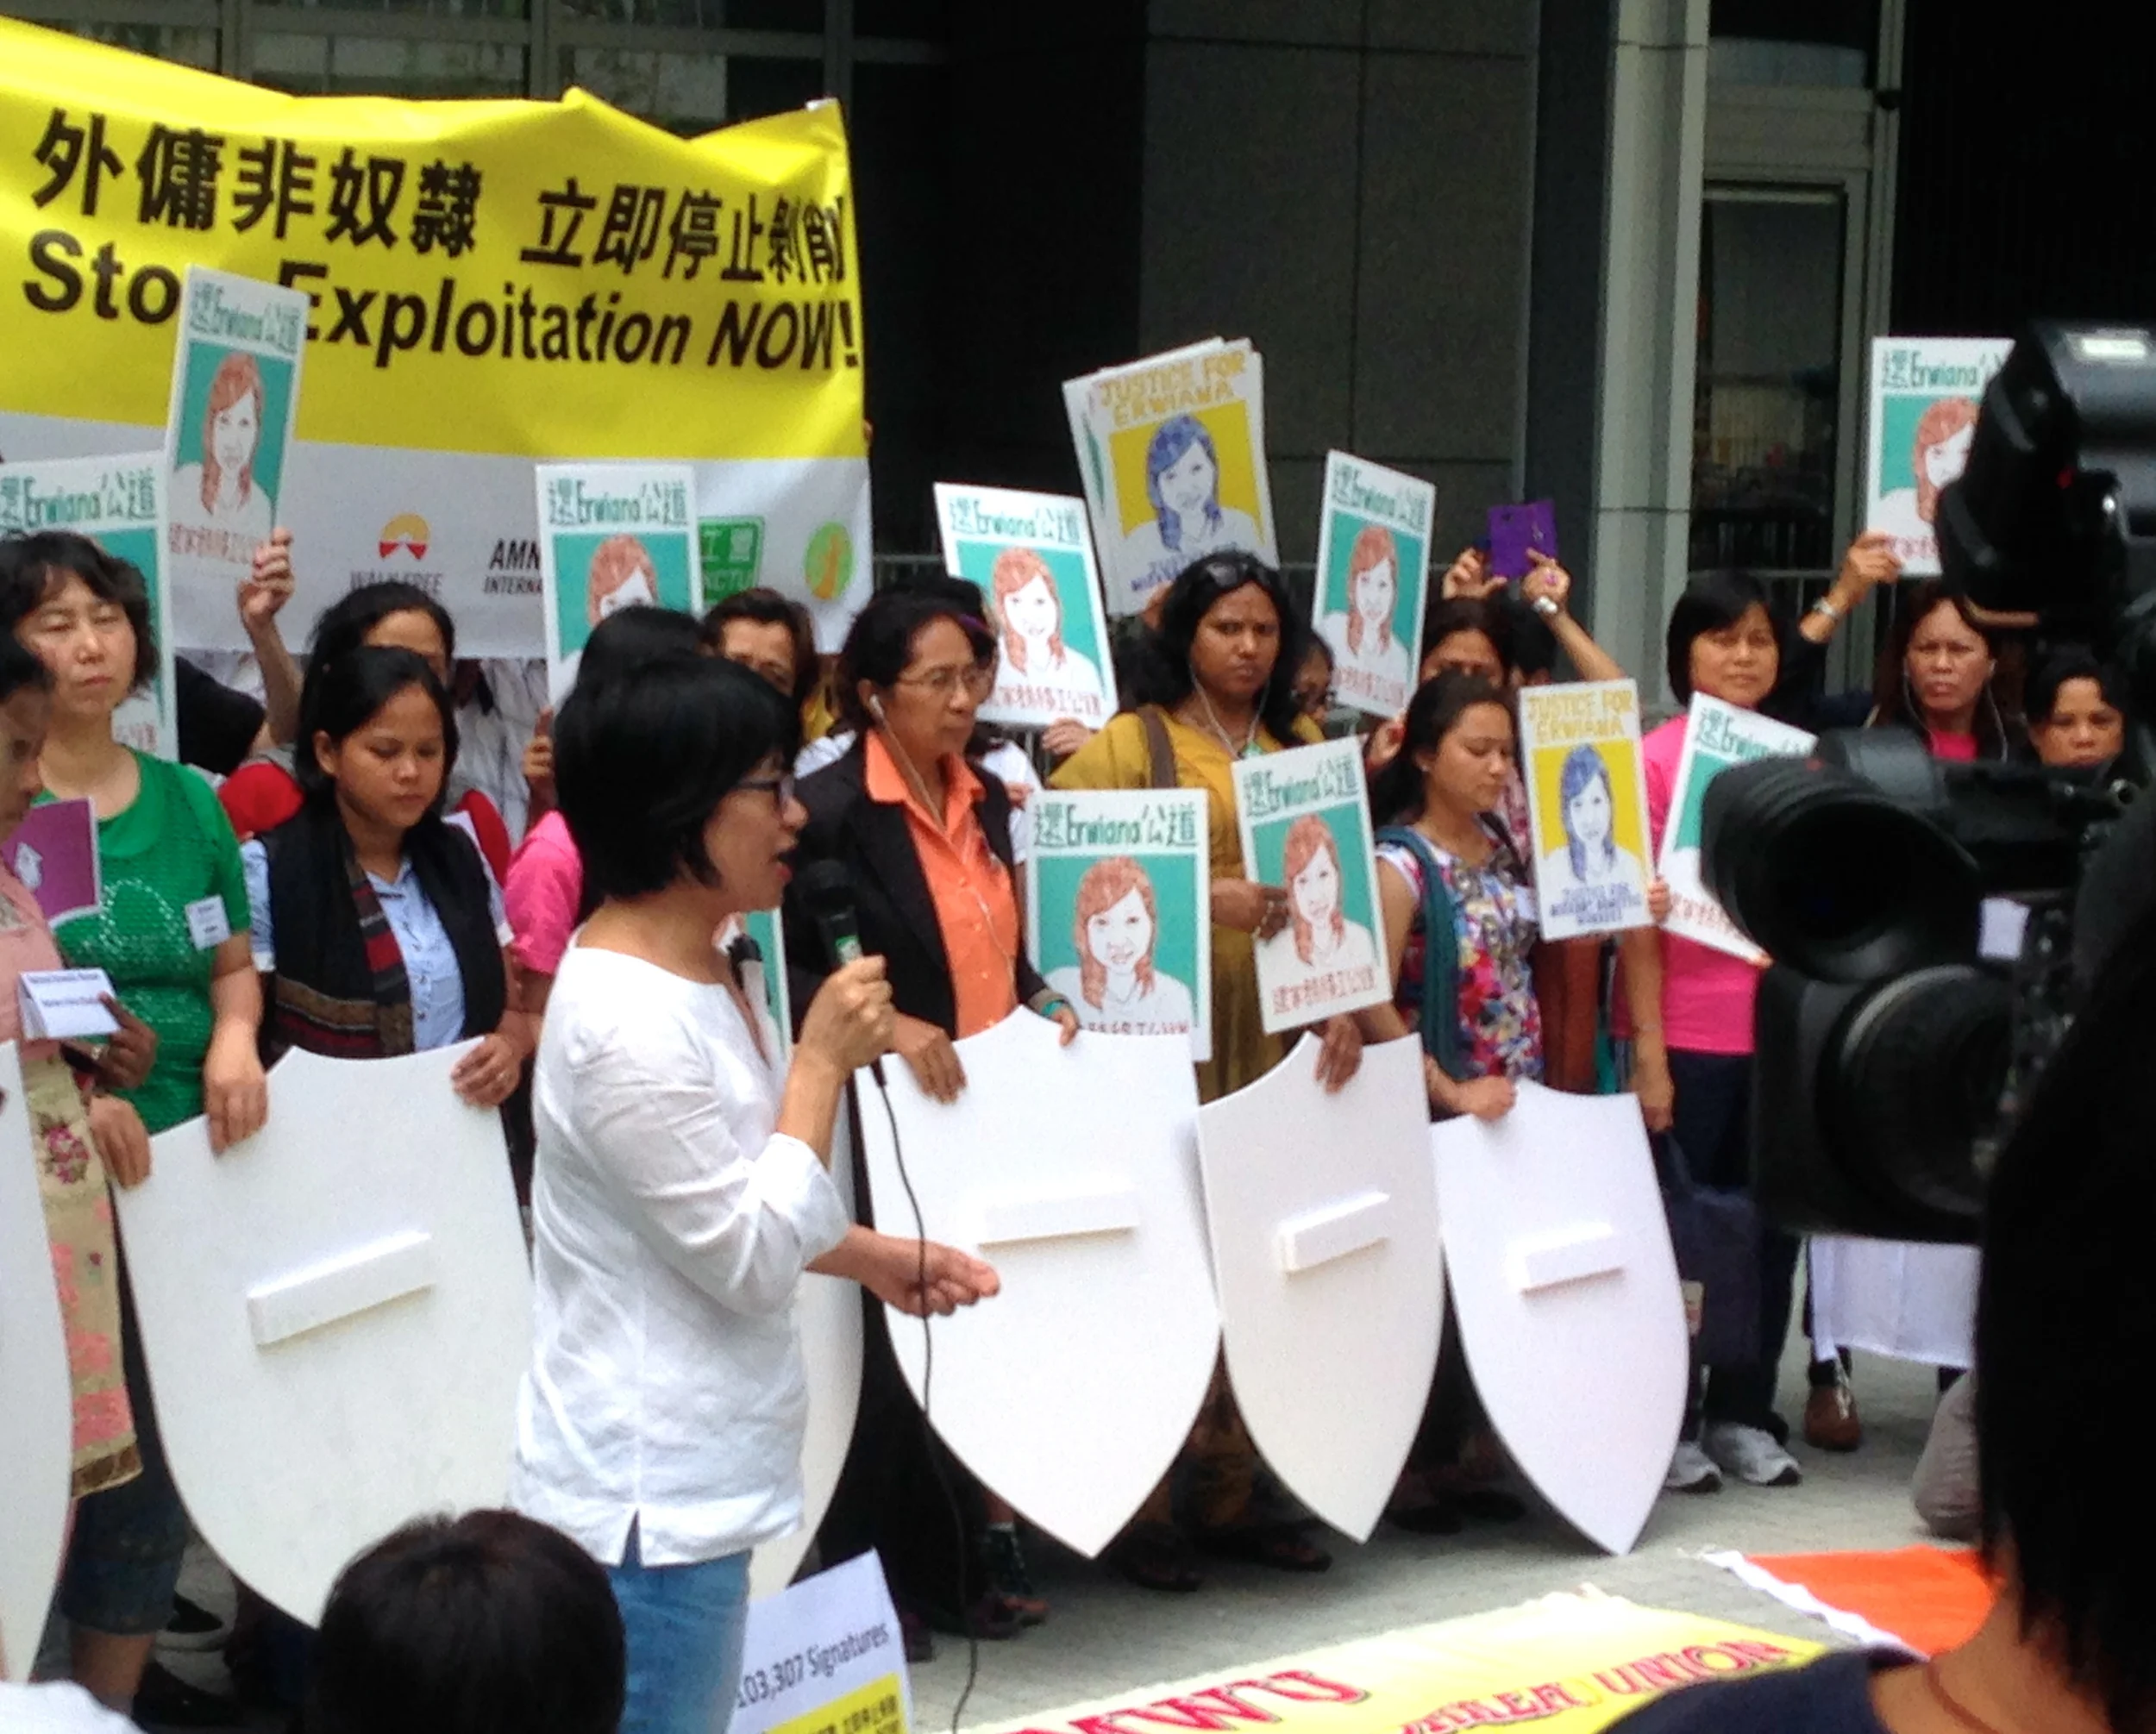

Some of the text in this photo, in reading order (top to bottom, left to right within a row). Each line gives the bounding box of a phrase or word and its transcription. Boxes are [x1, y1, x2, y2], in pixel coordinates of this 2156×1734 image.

[23, 229, 860, 370] Sto Exploitation NOW!
[1098, 349, 1245, 407] JUSTICE FOR
[1114, 378, 1235, 427] ERWIANA
[1603, 690, 1633, 713] FOR
[806, 1623, 890, 1678] Signatures
[1593, 1640, 1793, 1695] UNION
